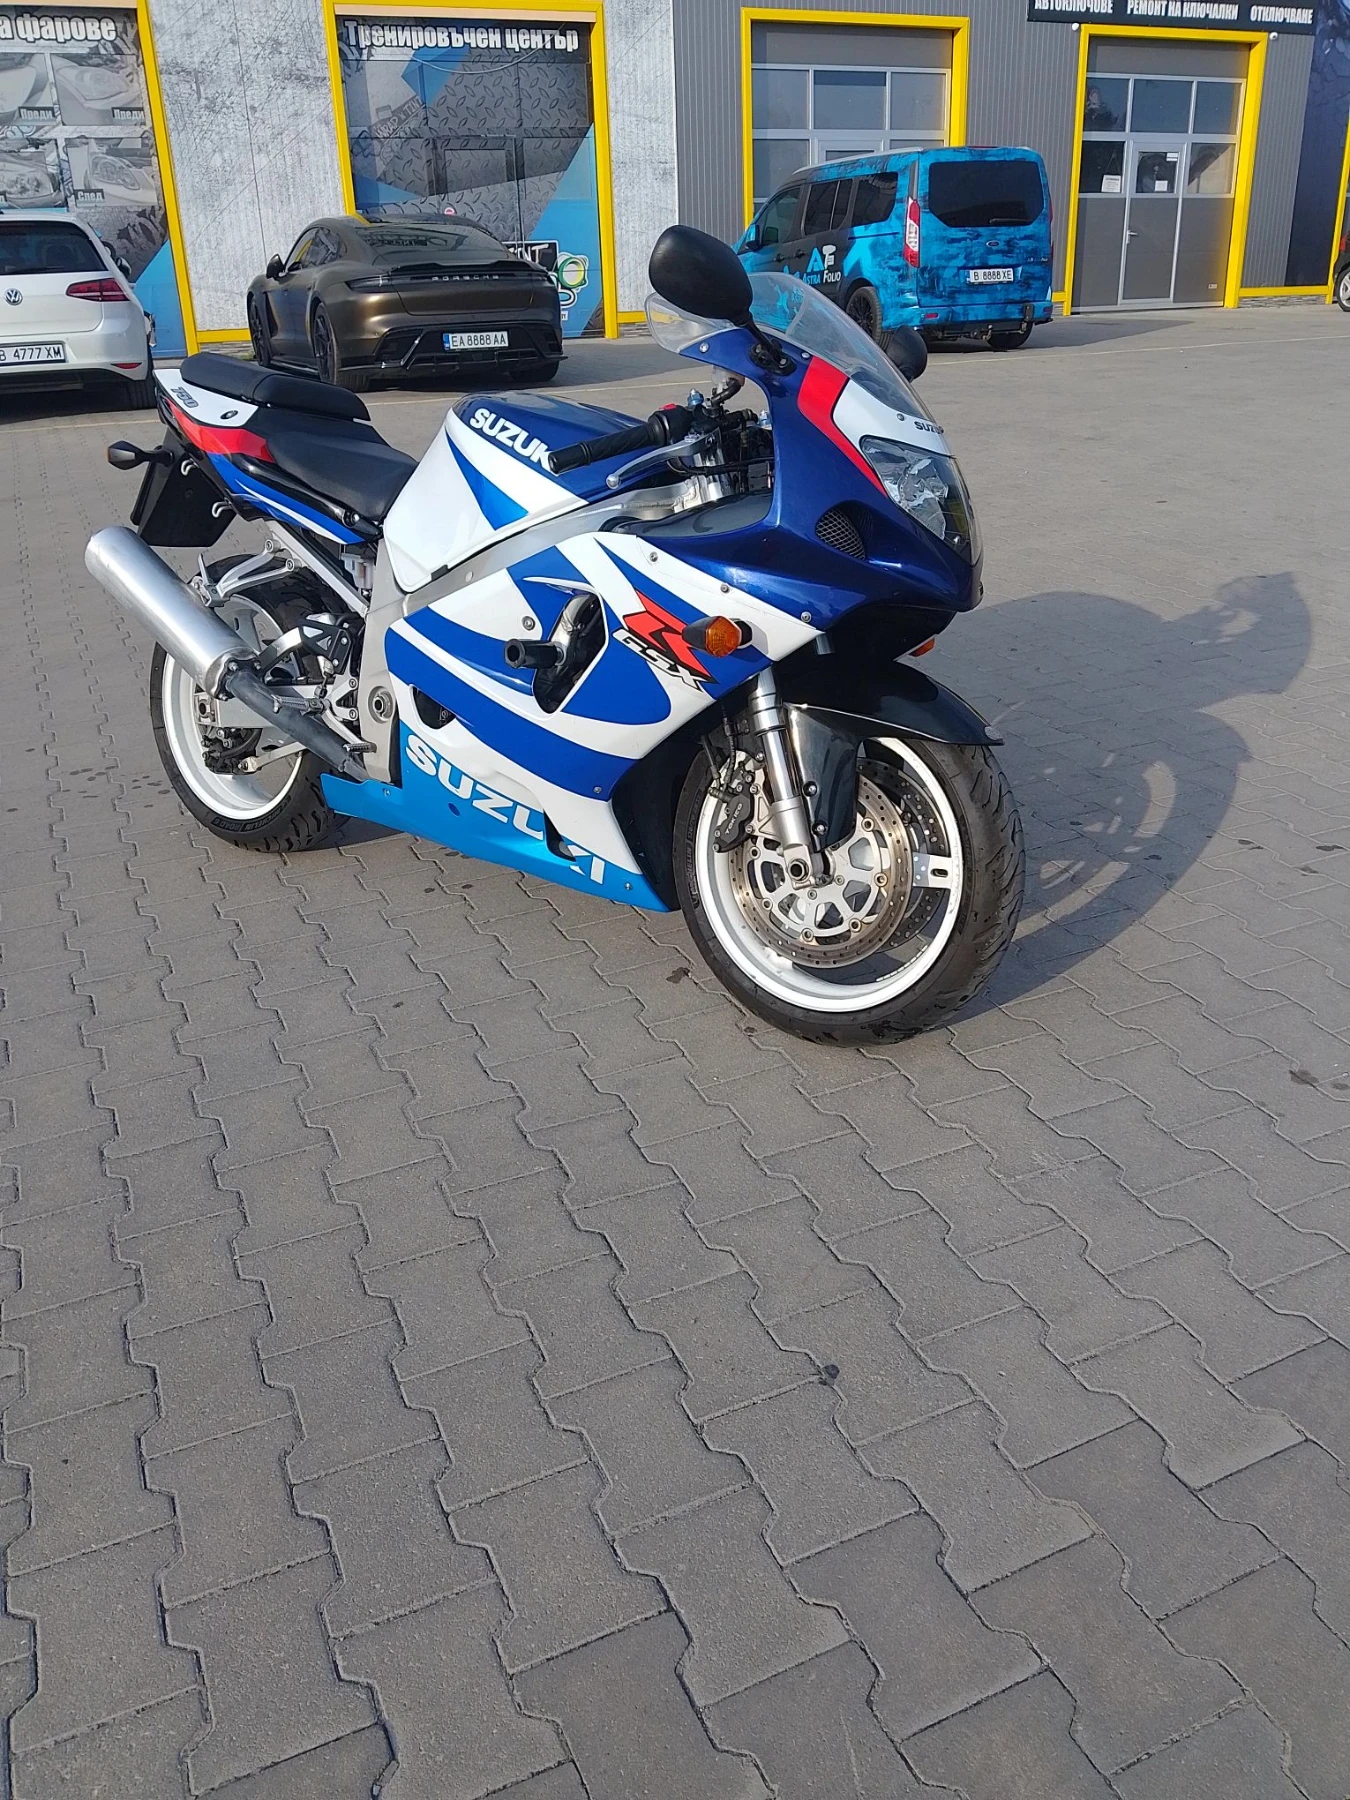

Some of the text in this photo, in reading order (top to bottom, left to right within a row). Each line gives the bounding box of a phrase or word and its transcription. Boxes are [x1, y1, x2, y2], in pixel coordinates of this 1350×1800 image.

[1034, 0, 1114, 14] АВТОКЛЮЧОВЕ
[1127, 0, 1239, 20] РЕМОНТ НА КЛЮЧАЛКИ
[1250, 5, 1313, 24] ОТКЛЮЧВАНЕ
[16, 12, 117, 43] фарове
[344, 20, 578, 52] Тренировъчен център
[451, 332, 507, 348] EA 8888 AA
[13, 346, 42, 360] 4777
[44, 346, 62, 359] XM
[170, 386, 199, 408] 750
[469, 407, 553, 475] SUZUK
